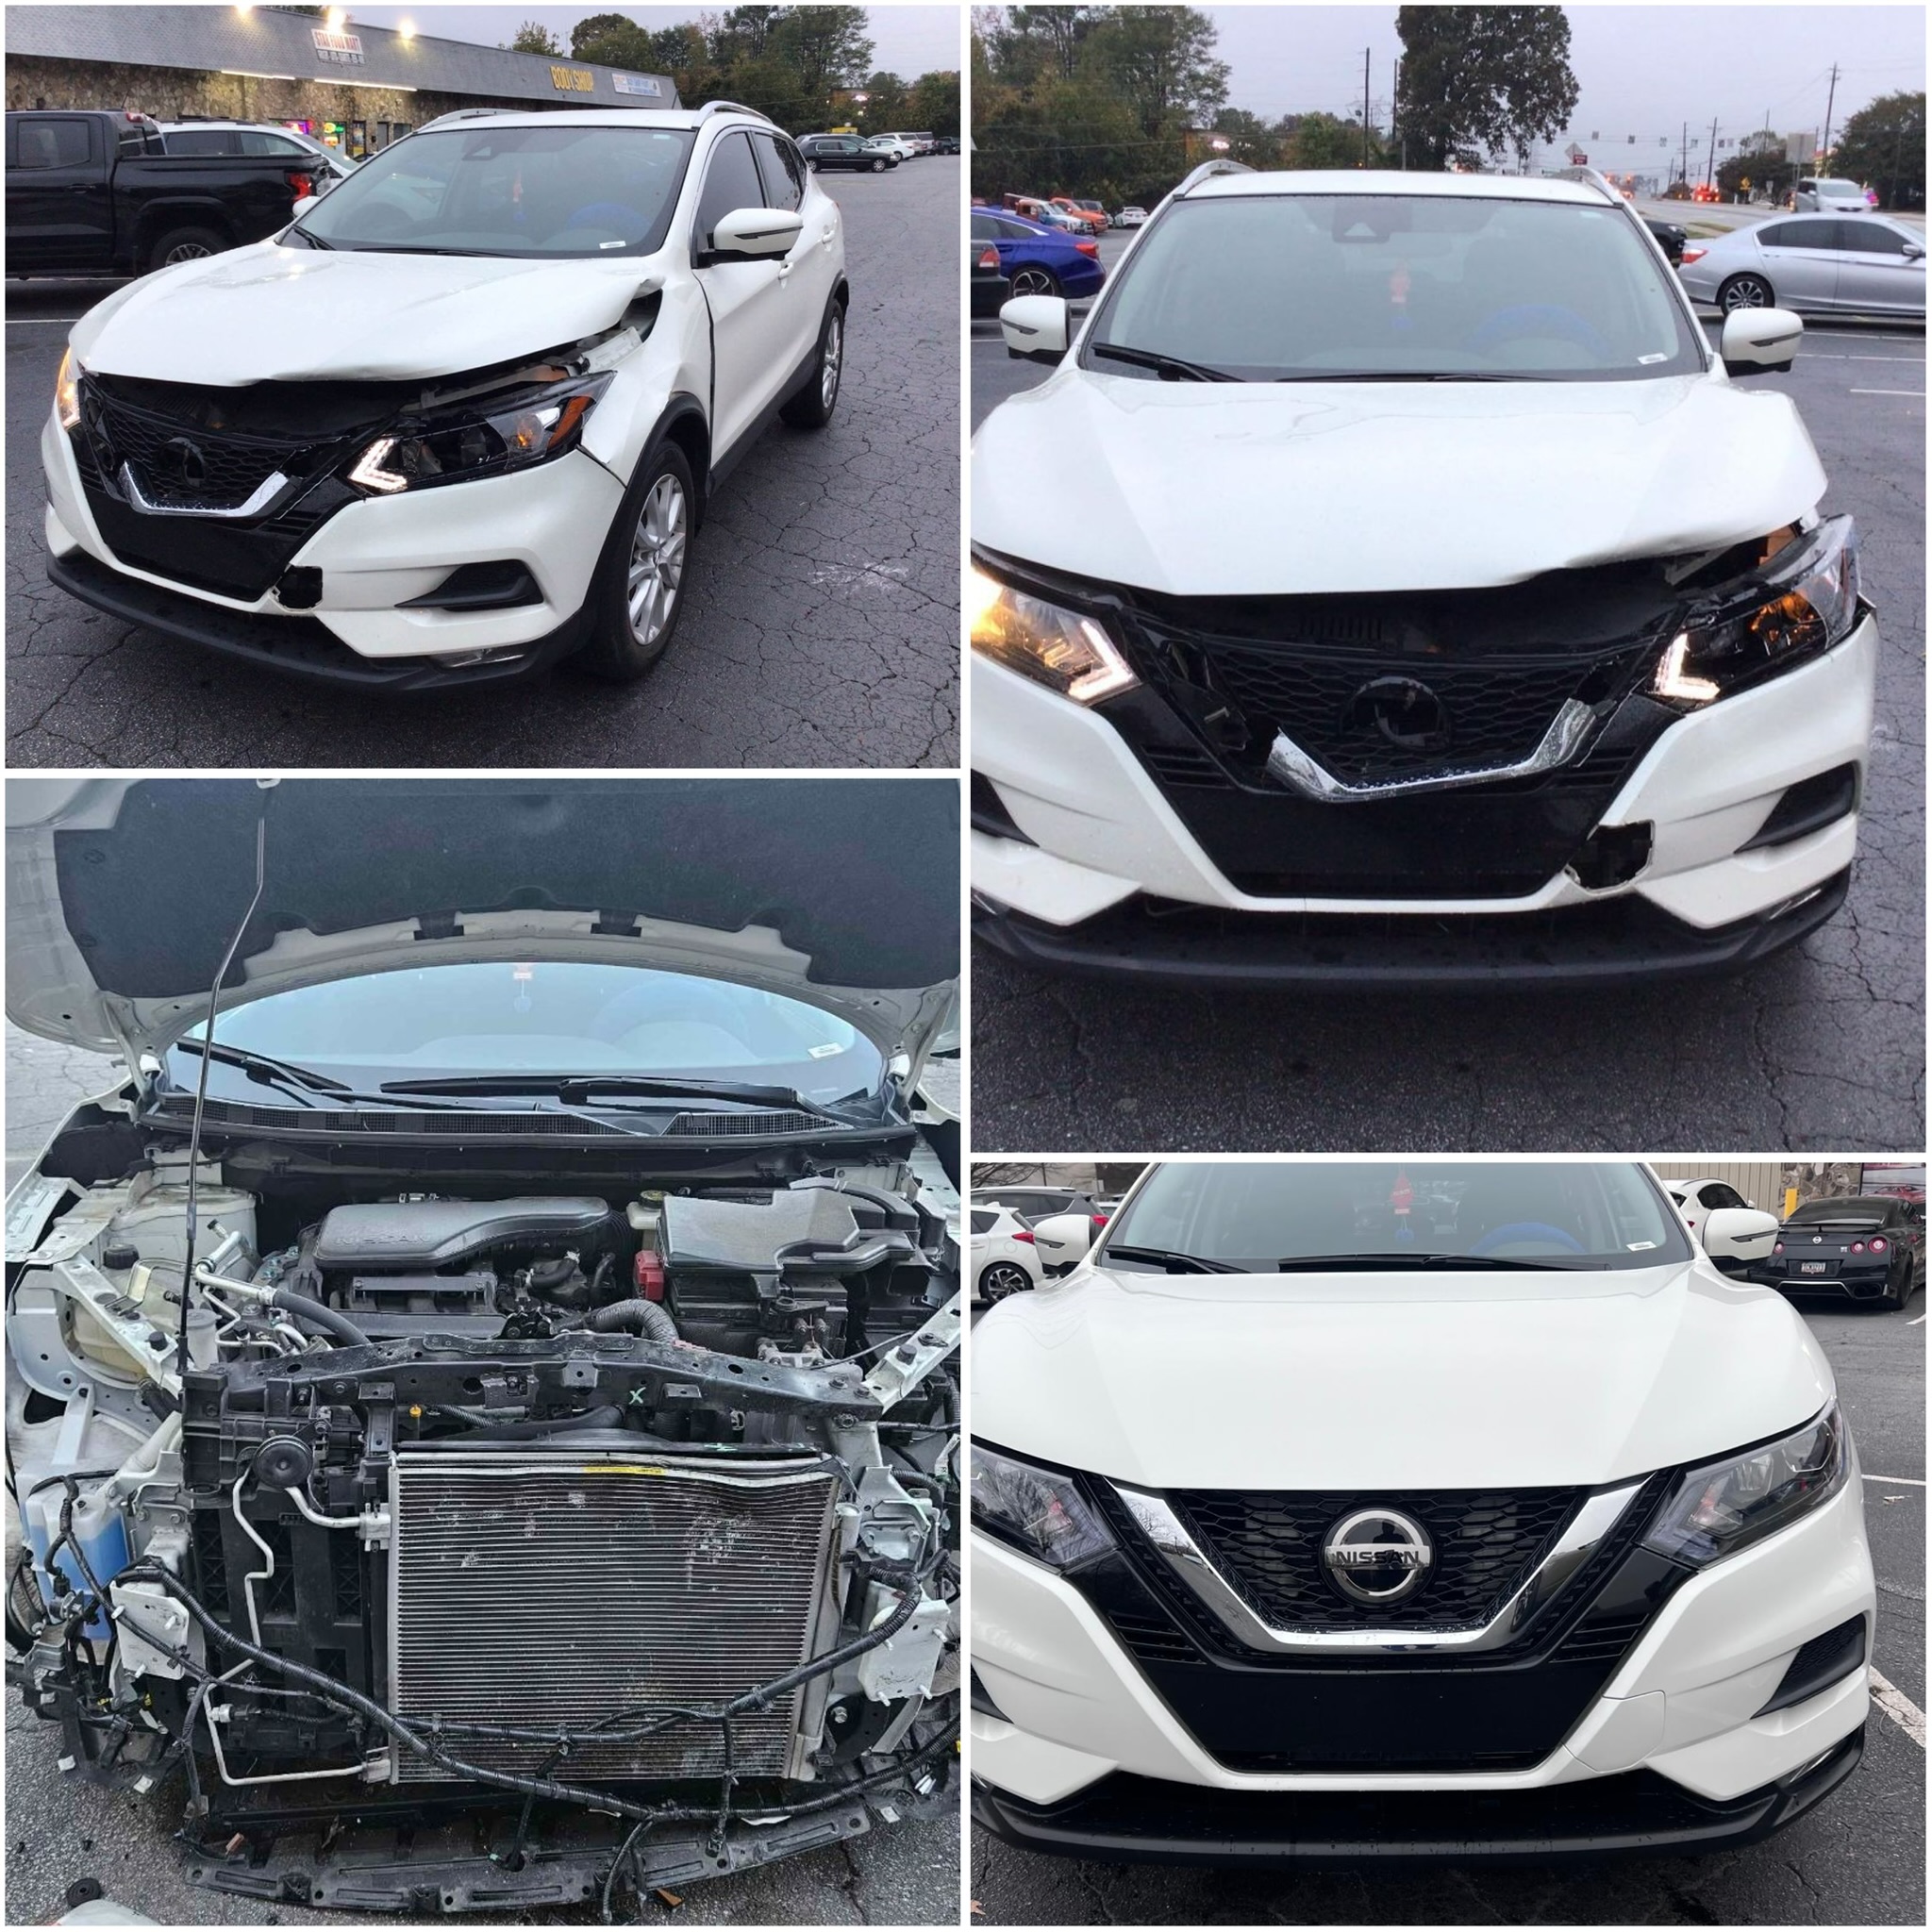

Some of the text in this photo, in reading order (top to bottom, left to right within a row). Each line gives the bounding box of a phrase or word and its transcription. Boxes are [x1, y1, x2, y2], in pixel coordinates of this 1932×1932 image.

[550, 66, 575, 91] BODY
[573, 70, 593, 92] SHOP
[1336, 1550, 1419, 1564] NISSAN
